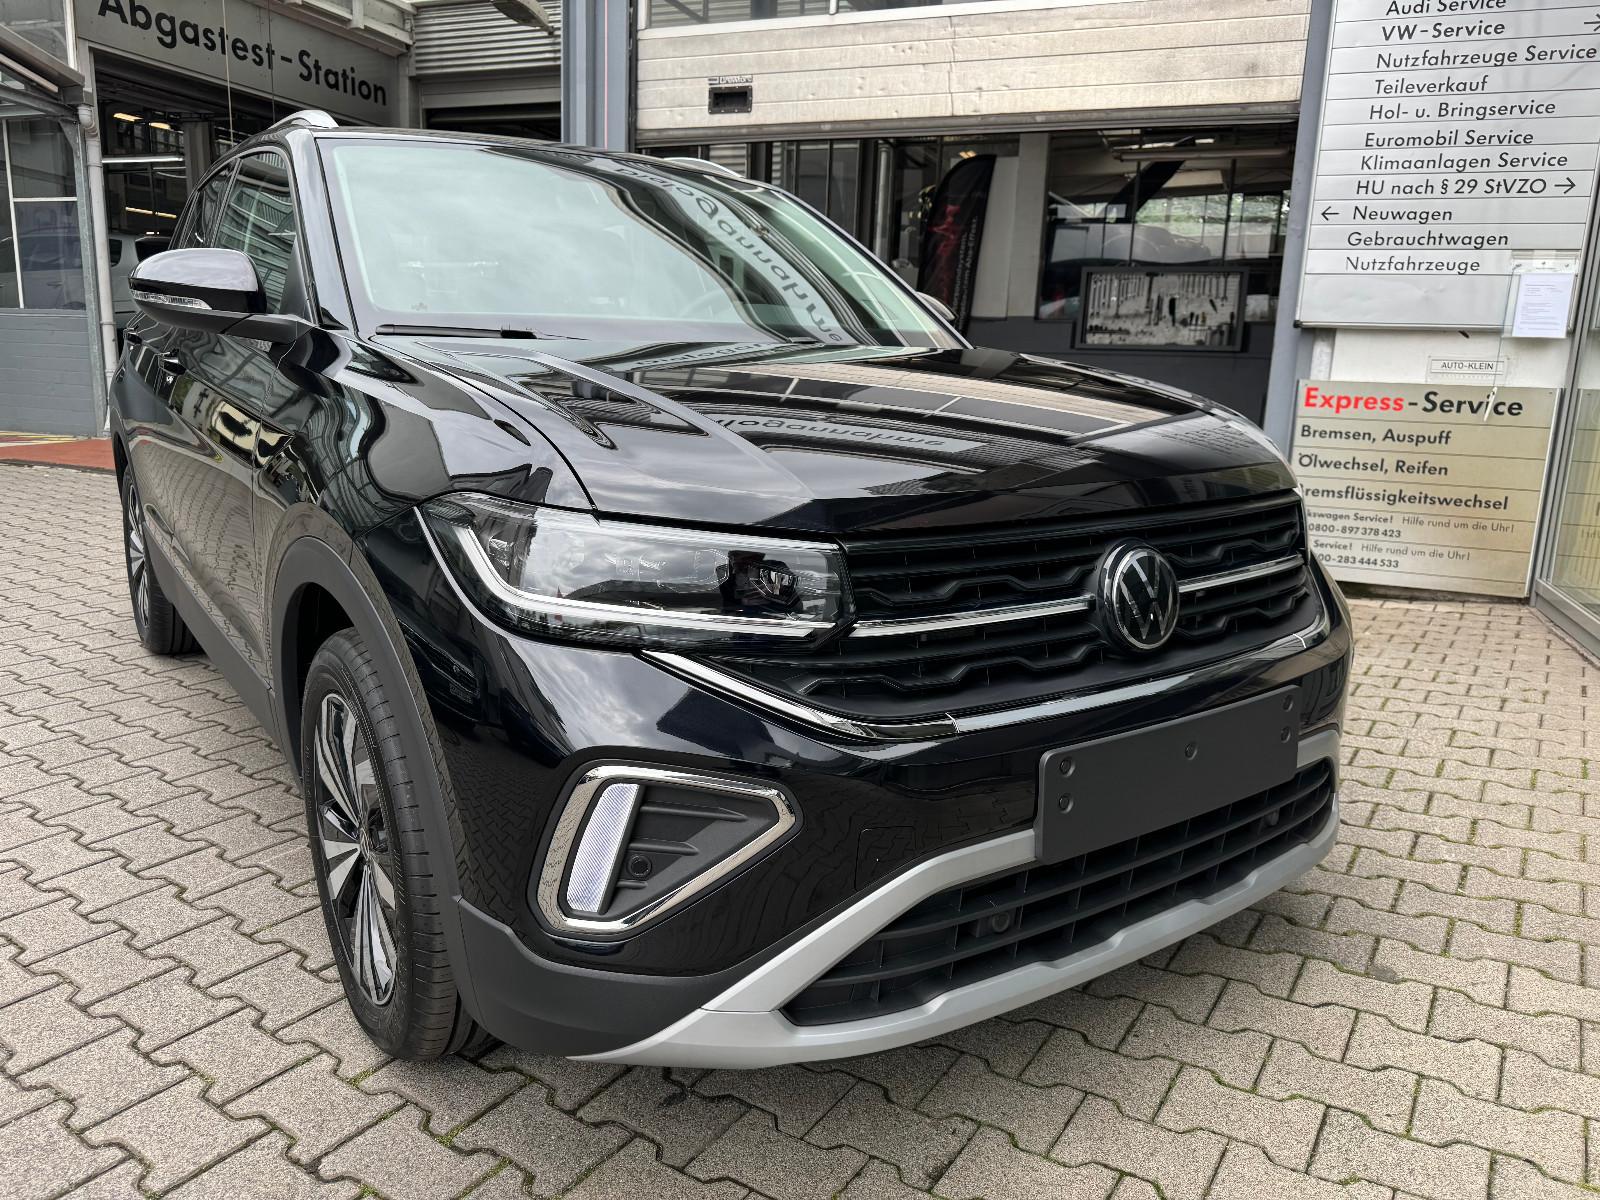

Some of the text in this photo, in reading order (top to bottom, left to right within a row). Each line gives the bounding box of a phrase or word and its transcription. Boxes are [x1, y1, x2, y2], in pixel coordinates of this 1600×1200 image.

[1386, 0, 1506, 15] Audi Service
[1382, 20, 1505, 41] VW-Service
[1376, 44, 1597, 69] Nutzfahrzeuge Service
[1375, 75, 1488, 94] Teileverkauf
[1370, 100, 1556, 120] Hol- u. Bringservice
[1365, 129, 1534, 147] Euromobil Service
[1361, 151, 1568, 172] Klimaanlagen Service
[1356, 178, 1547, 195] HU nach § 29 StVZO
[1352, 206, 1453, 224] Neuwagen
[1347, 230, 1509, 250] Gebrauchtwagen
[1346, 256, 1481, 275] Nutzfahrzeuge
[1441, 361, 1494, 370] AUTO-KLEIN
[1301, 425, 1452, 446] Bremsen, Auspuff
[1298, 453, 1448, 476] Ölwechsel, Reifen
[1300, 483, 1508, 511] remsflüssigkeitswechsel
[1306, 509, 1350, 521] kswagen
[1353, 513, 1393, 523] Service!
[1402, 516, 1424, 526] Hilfe
[1428, 519, 1451, 528] rund
[1472, 521, 1487, 531] die
[1491, 522, 1514, 533] Uhr!
[1313, 540, 1352, 551] Service!
[1361, 544, 1383, 553] Hilfe
[1386, 546, 1408, 555] rund
[1429, 548, 1444, 558] die
[1447, 550, 1470, 560] Uhr!
